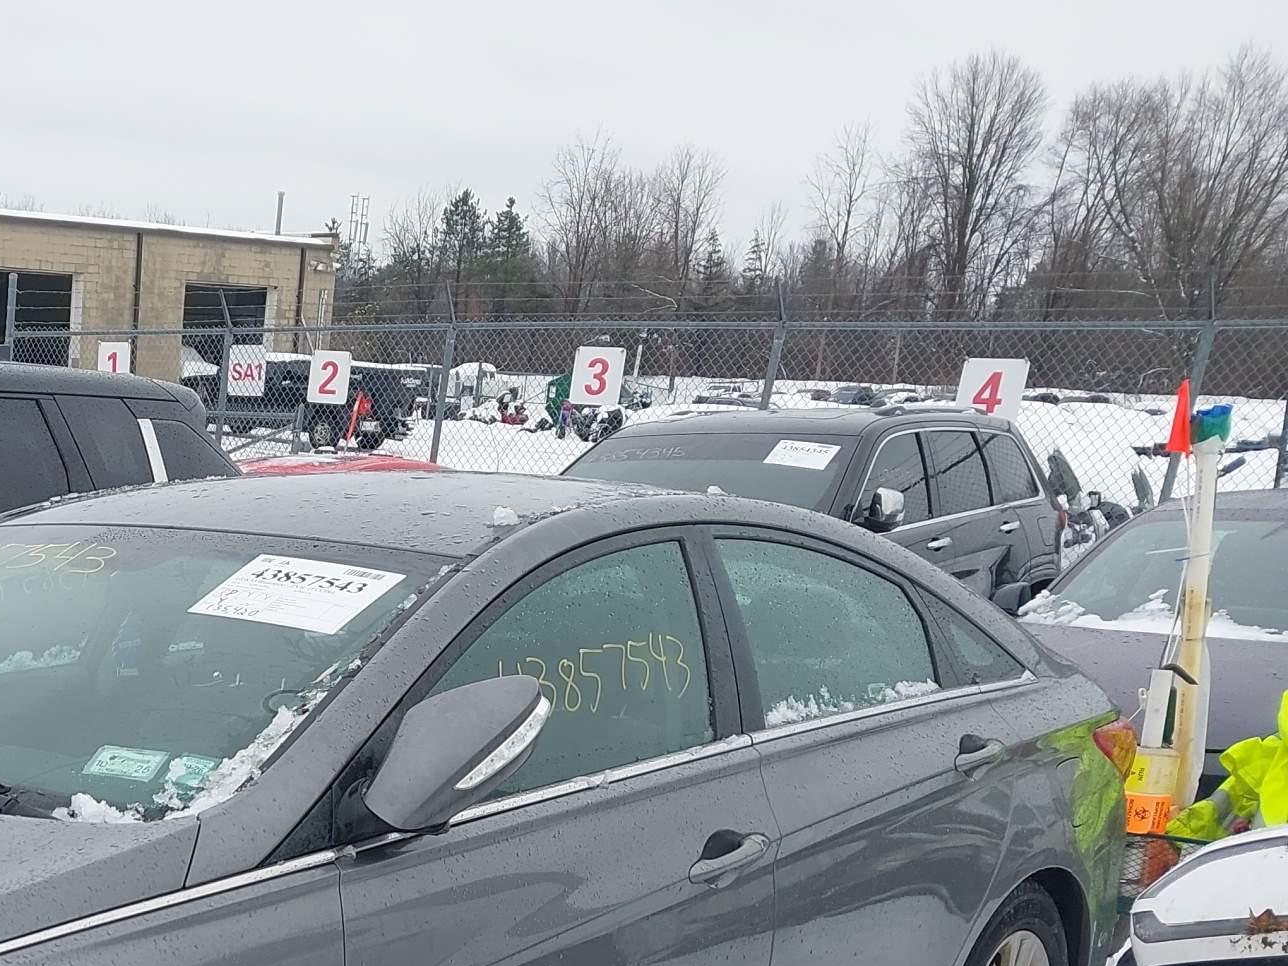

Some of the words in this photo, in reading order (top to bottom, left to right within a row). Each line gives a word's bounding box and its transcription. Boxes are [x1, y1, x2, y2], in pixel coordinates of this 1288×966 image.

[107, 351, 117, 373] 1
[231, 362, 262, 381] SA1
[317, 360, 339, 395] 2
[584, 357, 609, 396] 3
[972, 371, 1003, 414] 4
[251, 567, 368, 594] 43857543
